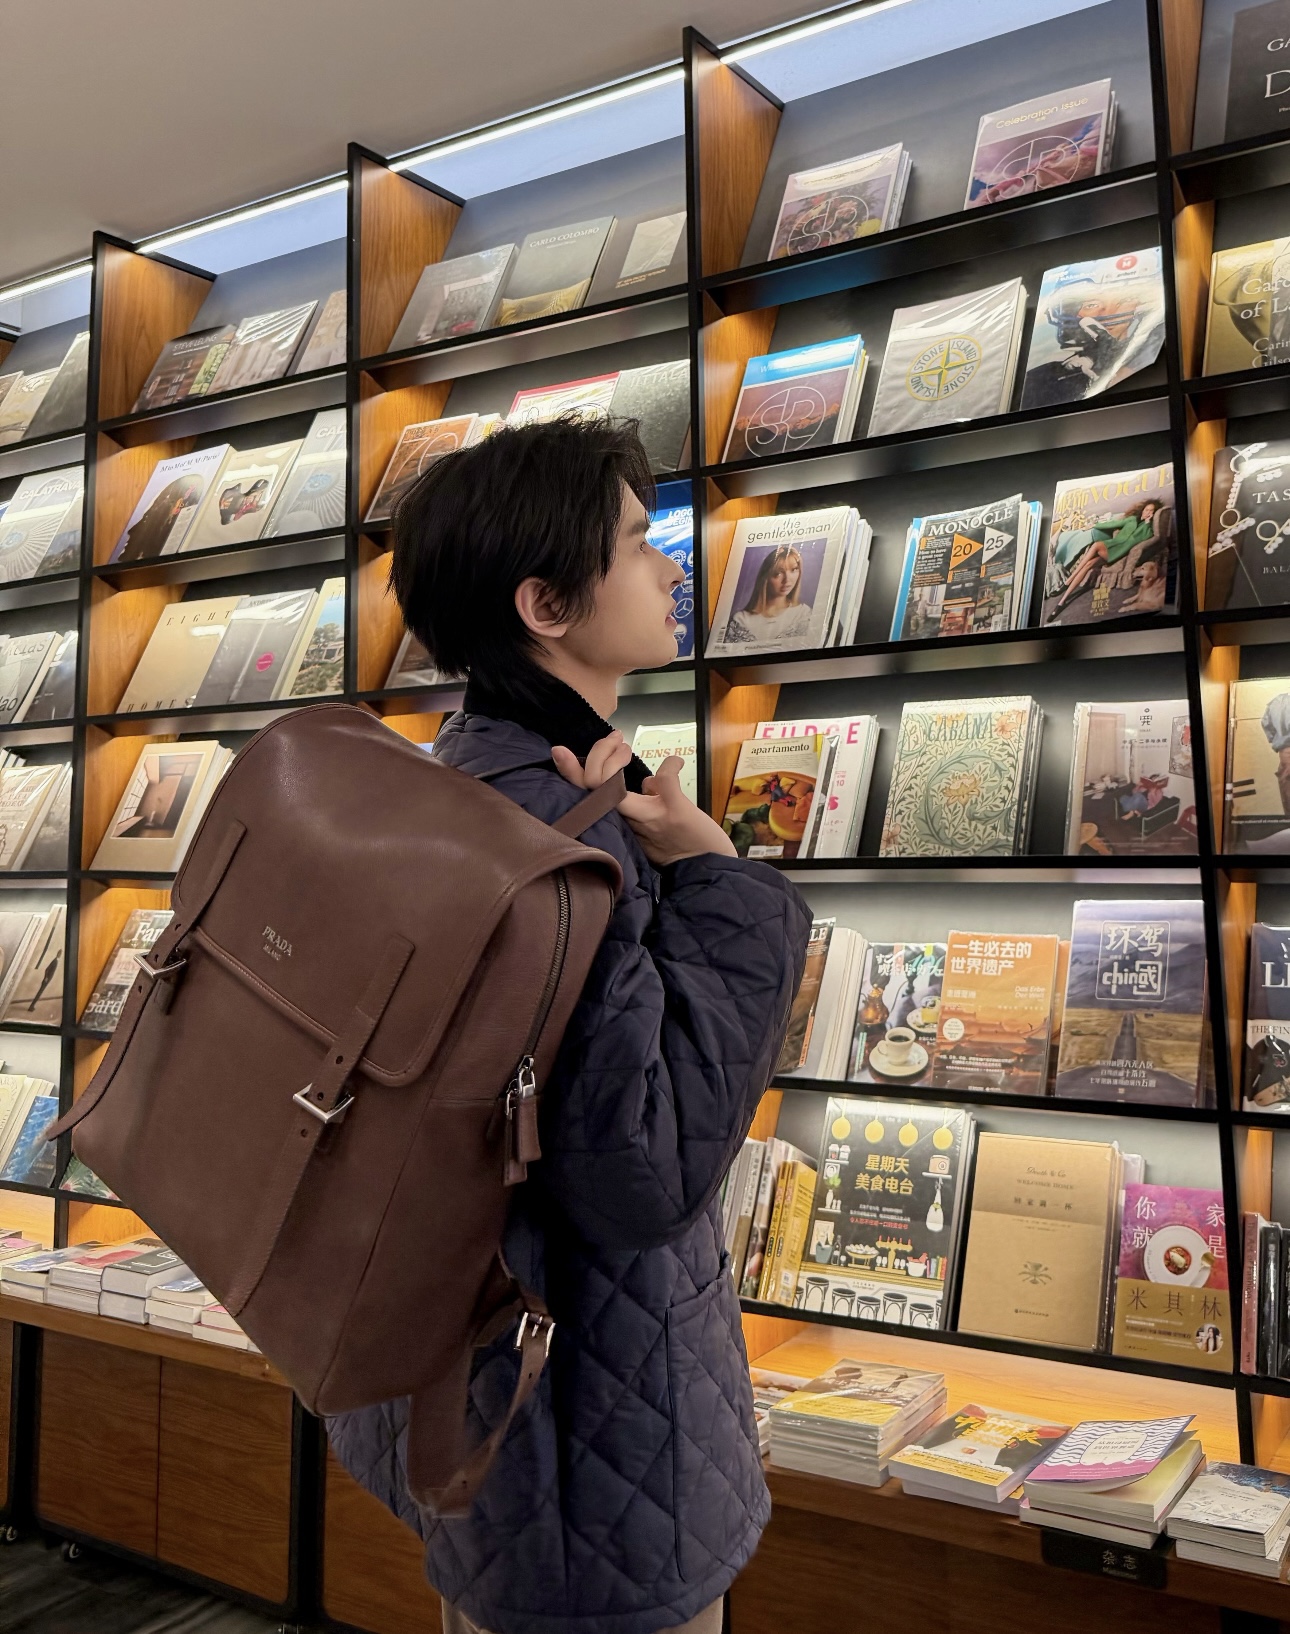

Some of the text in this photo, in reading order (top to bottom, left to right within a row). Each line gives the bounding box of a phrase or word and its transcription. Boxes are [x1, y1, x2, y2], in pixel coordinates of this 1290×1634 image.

[996, 97, 1089, 129] Celebration Issue
[529, 236, 557, 248] CARLO
[557, 227, 600, 241] COLOMBO
[1240, 297, 1290, 319] of L
[914, 340, 977, 372] STONE ISLAND
[910, 364, 974, 398] STONE ISLAND
[18, 480, 83, 500] CALATRAVA
[1089, 466, 1175, 505] VOGUE
[668, 508, 693, 519] LOGO
[782, 518, 801, 530] the
[928, 505, 1014, 537] MONOCLE
[747, 523, 832, 544] gentlewoman
[952, 542, 973, 558] 20
[985, 535, 1004, 552] 25
[166, 609, 233, 626] EIGHT
[928, 712, 993, 742] CABANA
[639, 747, 672, 760] JENS
[751, 743, 810, 755] apartamento
[262, 925, 292, 956] PRADA
[952, 940, 1032, 959] 一生必去的
[1105, 924, 1165, 957] 环驾
[951, 957, 1015, 976] 世界遗产
[865, 1154, 911, 1175] 星期天
[854, 1172, 915, 1196] 美食电台
[1128, 1286, 1223, 1322] 米其林
[1102, 1550, 1138, 1570] 杂志
